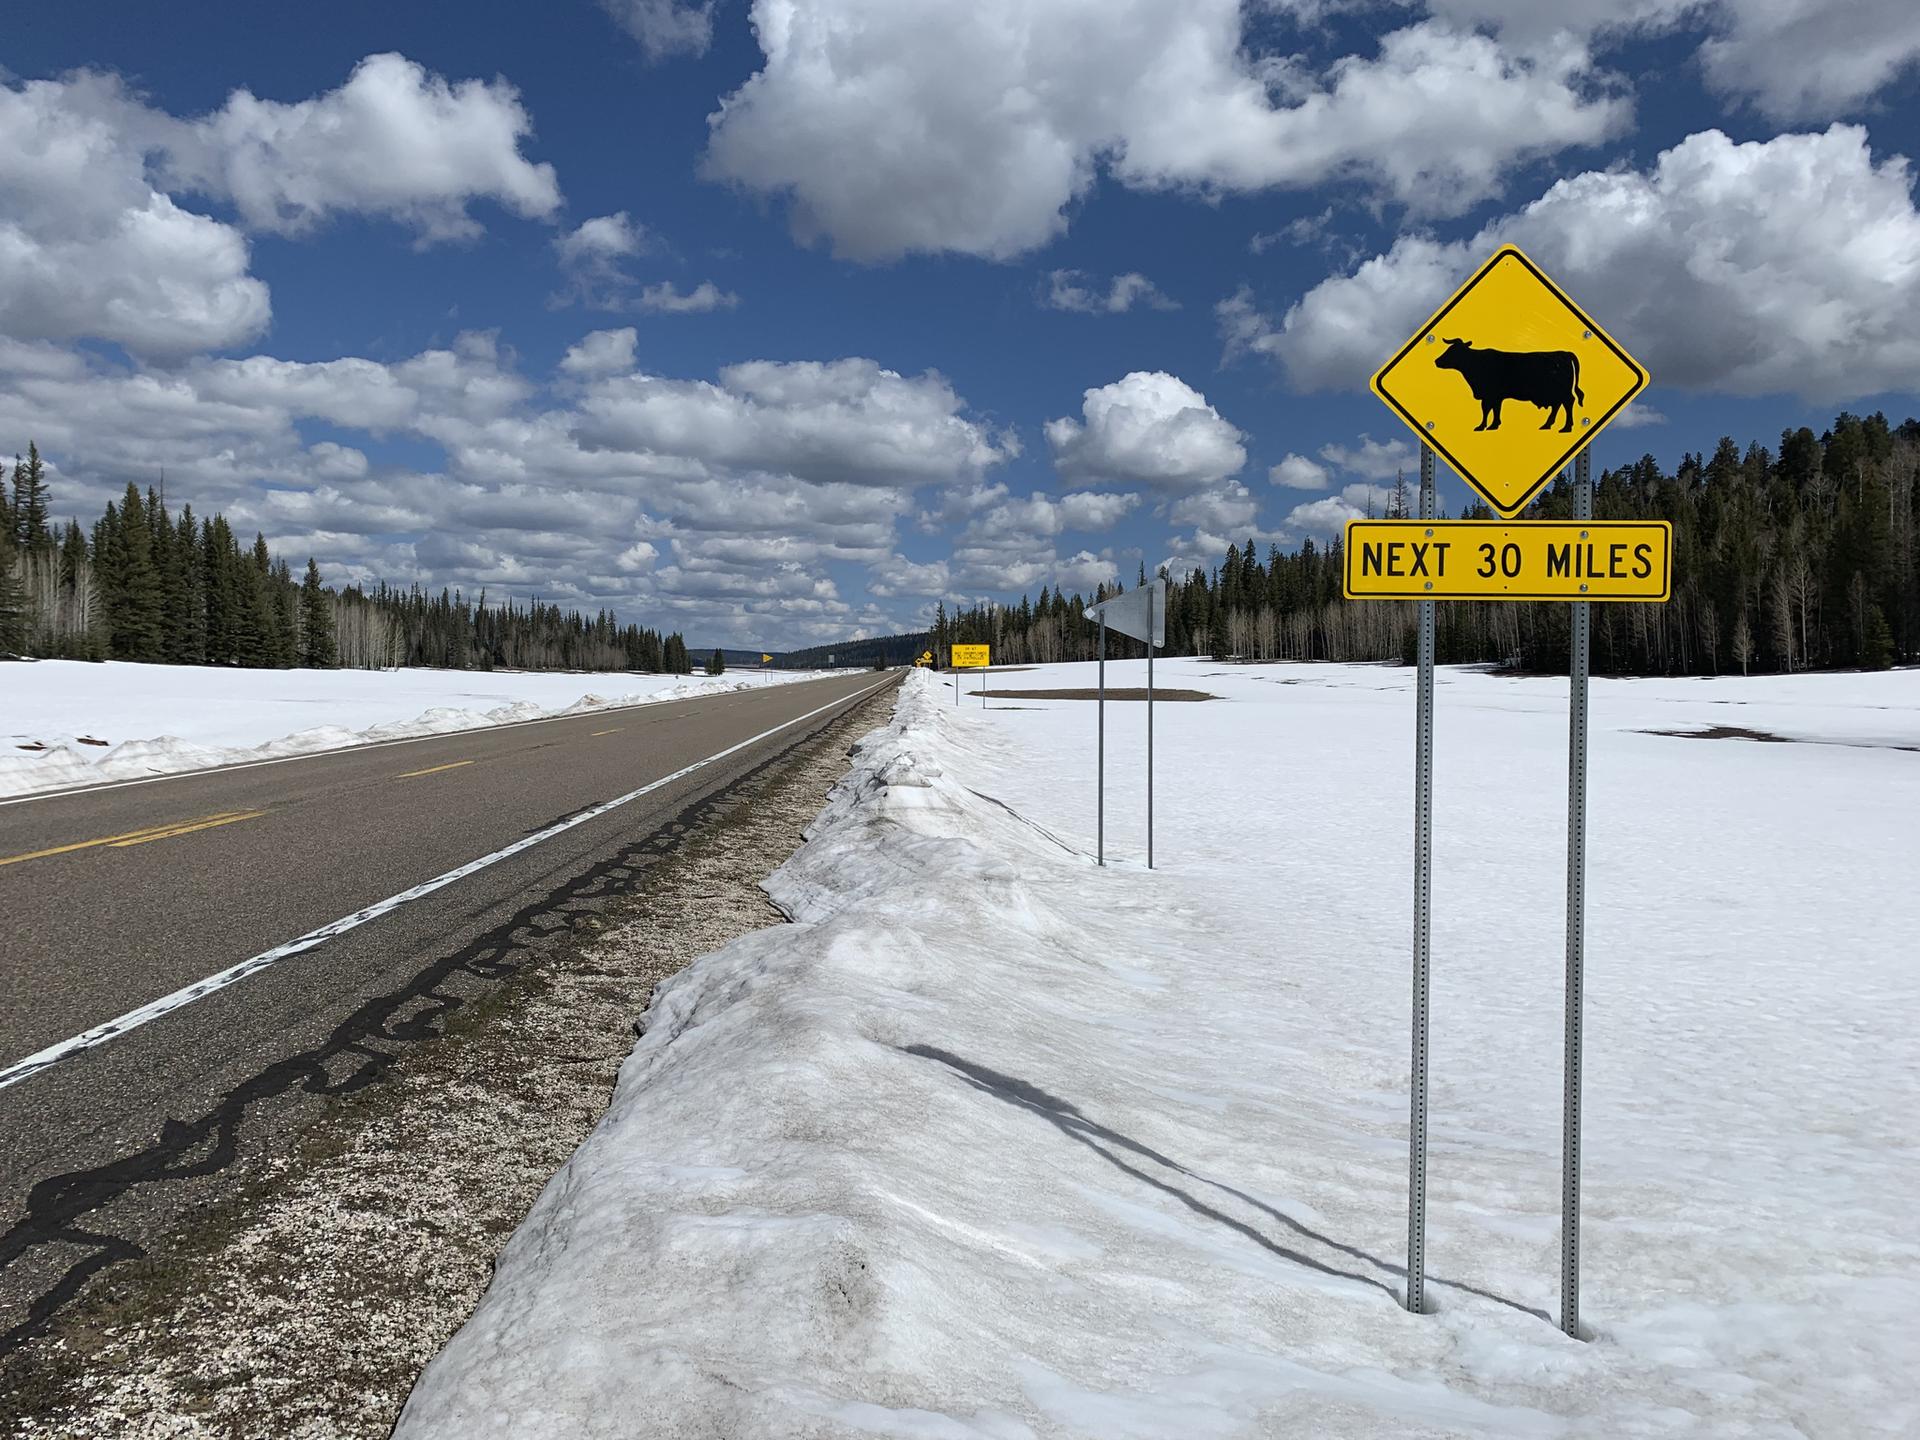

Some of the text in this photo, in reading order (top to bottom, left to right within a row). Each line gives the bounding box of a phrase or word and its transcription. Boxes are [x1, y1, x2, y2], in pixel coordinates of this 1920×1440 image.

[1362, 542, 1652, 578] NEXT 30 MILES
